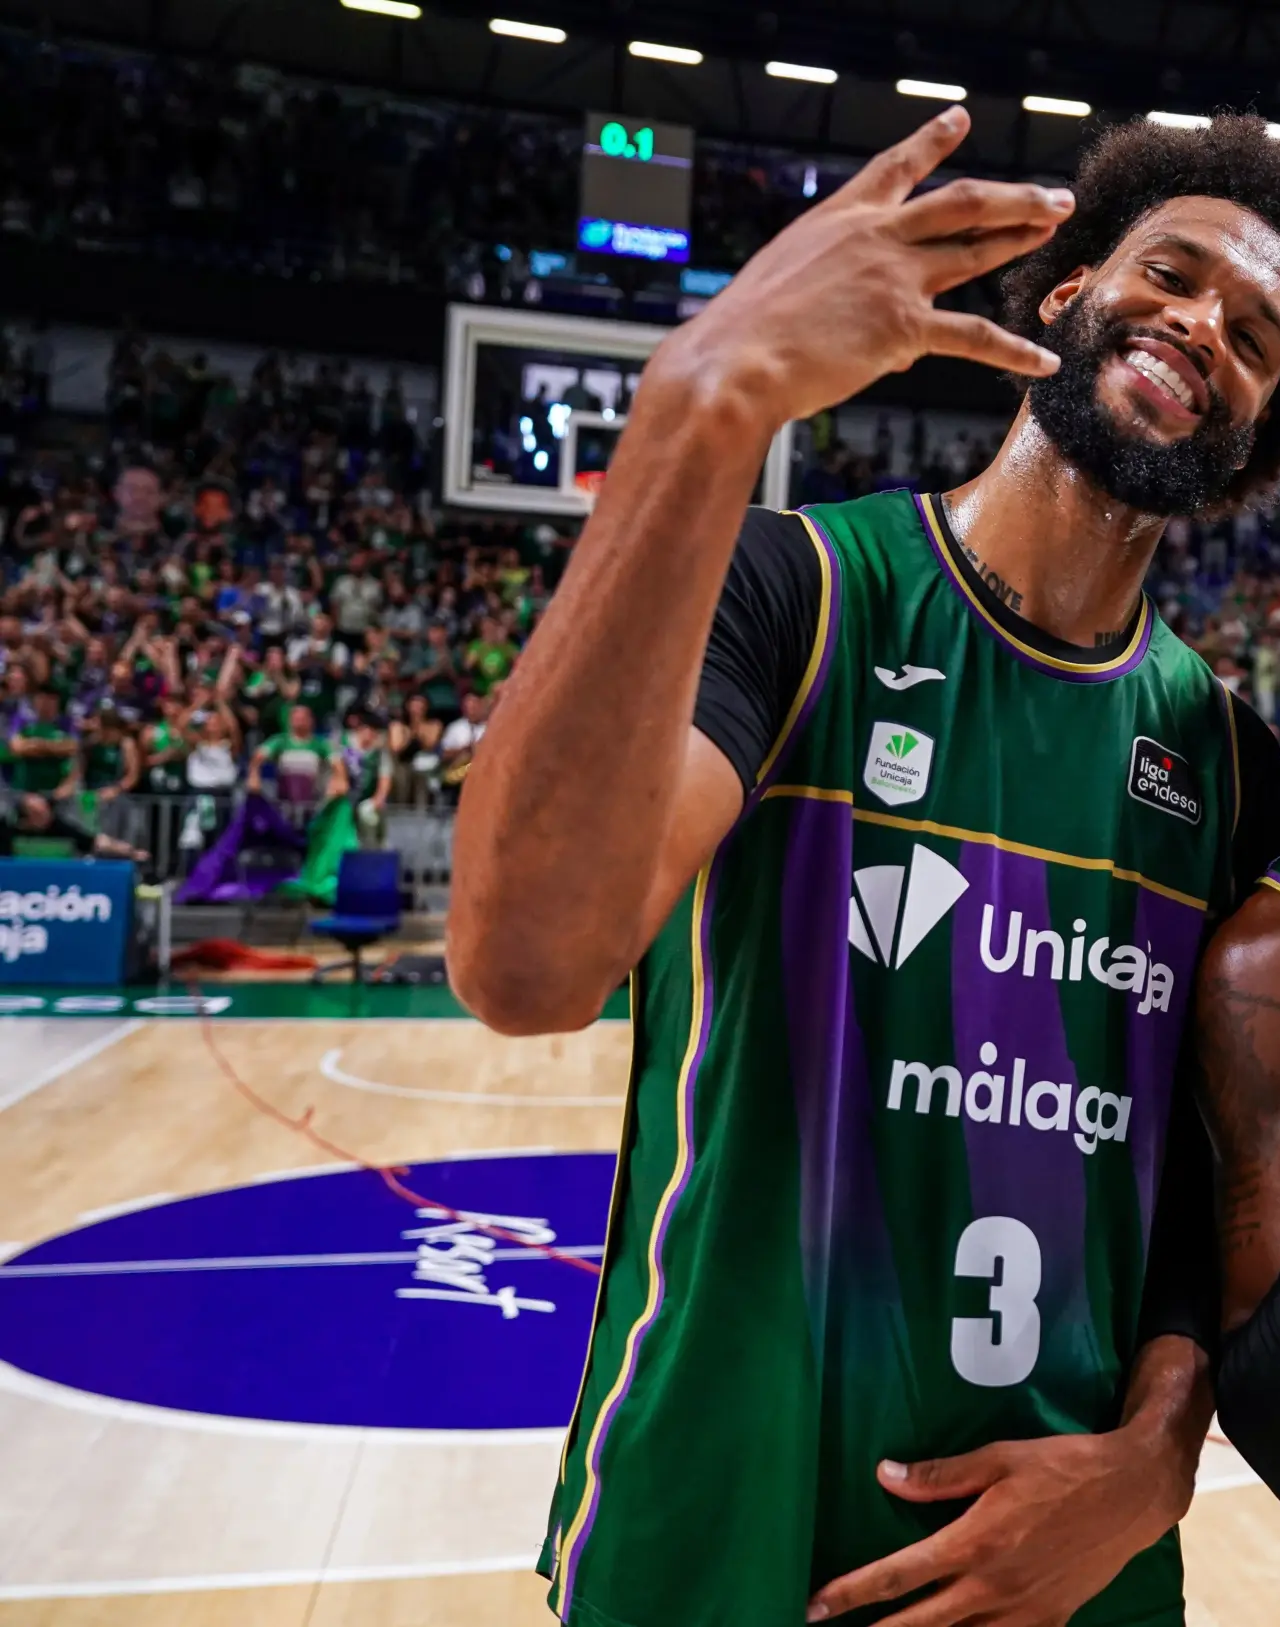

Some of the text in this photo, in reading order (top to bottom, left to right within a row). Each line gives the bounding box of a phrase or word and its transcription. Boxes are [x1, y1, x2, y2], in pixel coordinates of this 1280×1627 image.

[600, 121, 654, 162] 0.1
[874, 757, 920, 777] Fundación
[880, 769, 912, 786] Unicaja
[1140, 756, 1169, 782] liga
[1137, 778, 1197, 814] endesa
[979, 903, 1174, 1015] Unicaja
[950, 1215, 1042, 1387] 3
